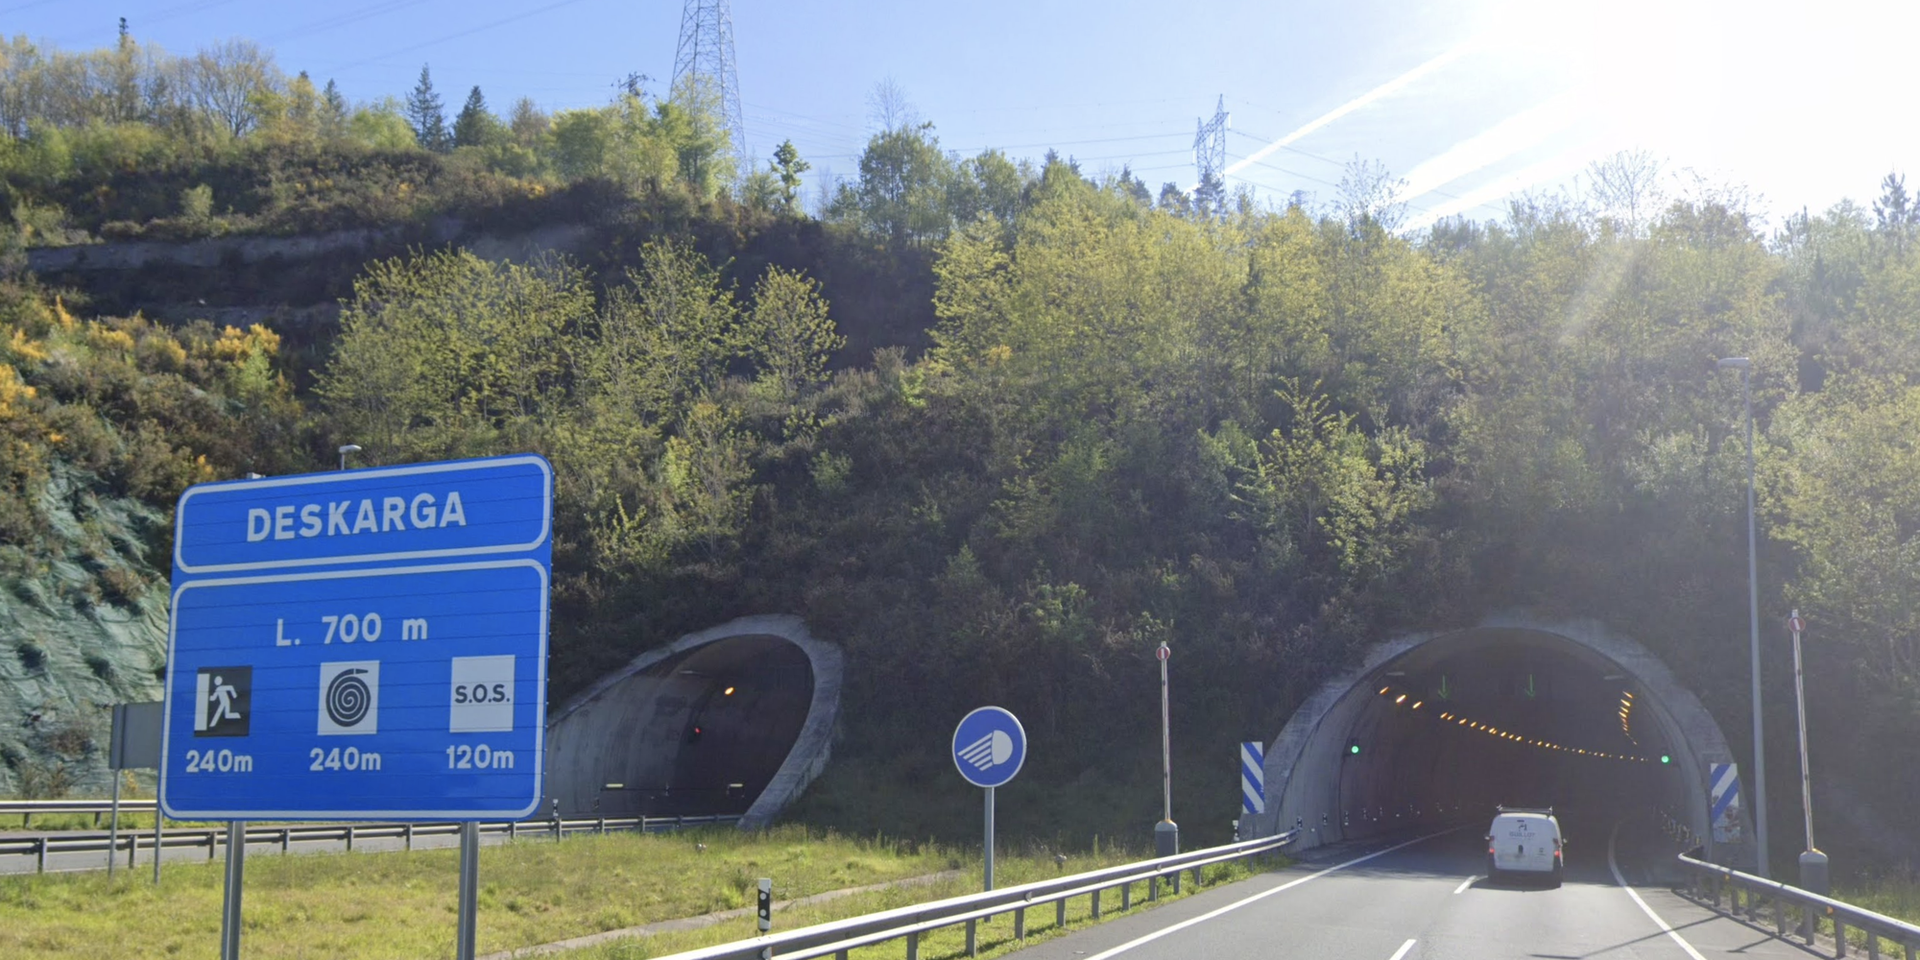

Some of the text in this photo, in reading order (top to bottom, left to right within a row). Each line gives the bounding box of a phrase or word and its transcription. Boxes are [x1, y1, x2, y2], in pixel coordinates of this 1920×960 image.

[247, 491, 466, 542] DESKARGA
[276, 613, 428, 646] L. 700 m
[455, 684, 510, 703] S.O.S.
[185, 749, 253, 773] 240m
[309, 747, 382, 771] 240m
[446, 744, 515, 769] 120m
